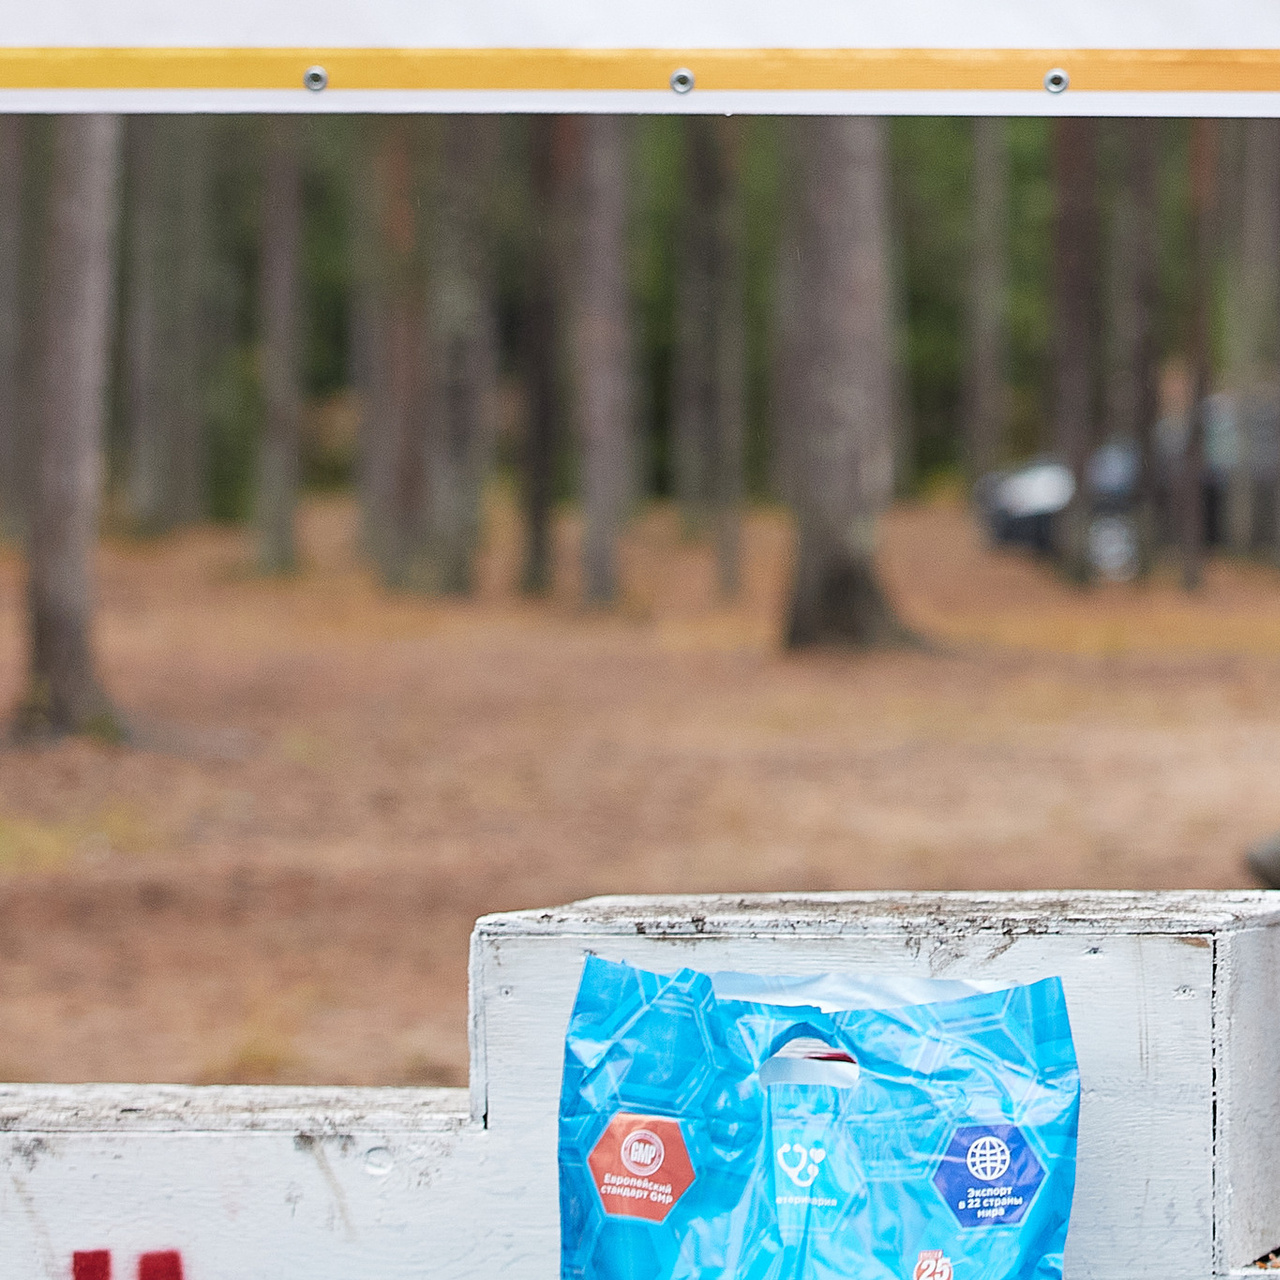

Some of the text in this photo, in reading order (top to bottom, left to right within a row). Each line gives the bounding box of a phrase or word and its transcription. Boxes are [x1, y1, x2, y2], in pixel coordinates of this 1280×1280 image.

[630, 1141, 657, 1165] GMP
[603, 1173, 672, 1194] Европейский
[600, 1185, 674, 1205] стандарт GMP
[967, 1187, 1013, 1199] Экспорт
[967, 1199, 981, 1209] 22
[982, 1197, 1024, 1209] страны
[976, 1208, 1006, 1219] мира
